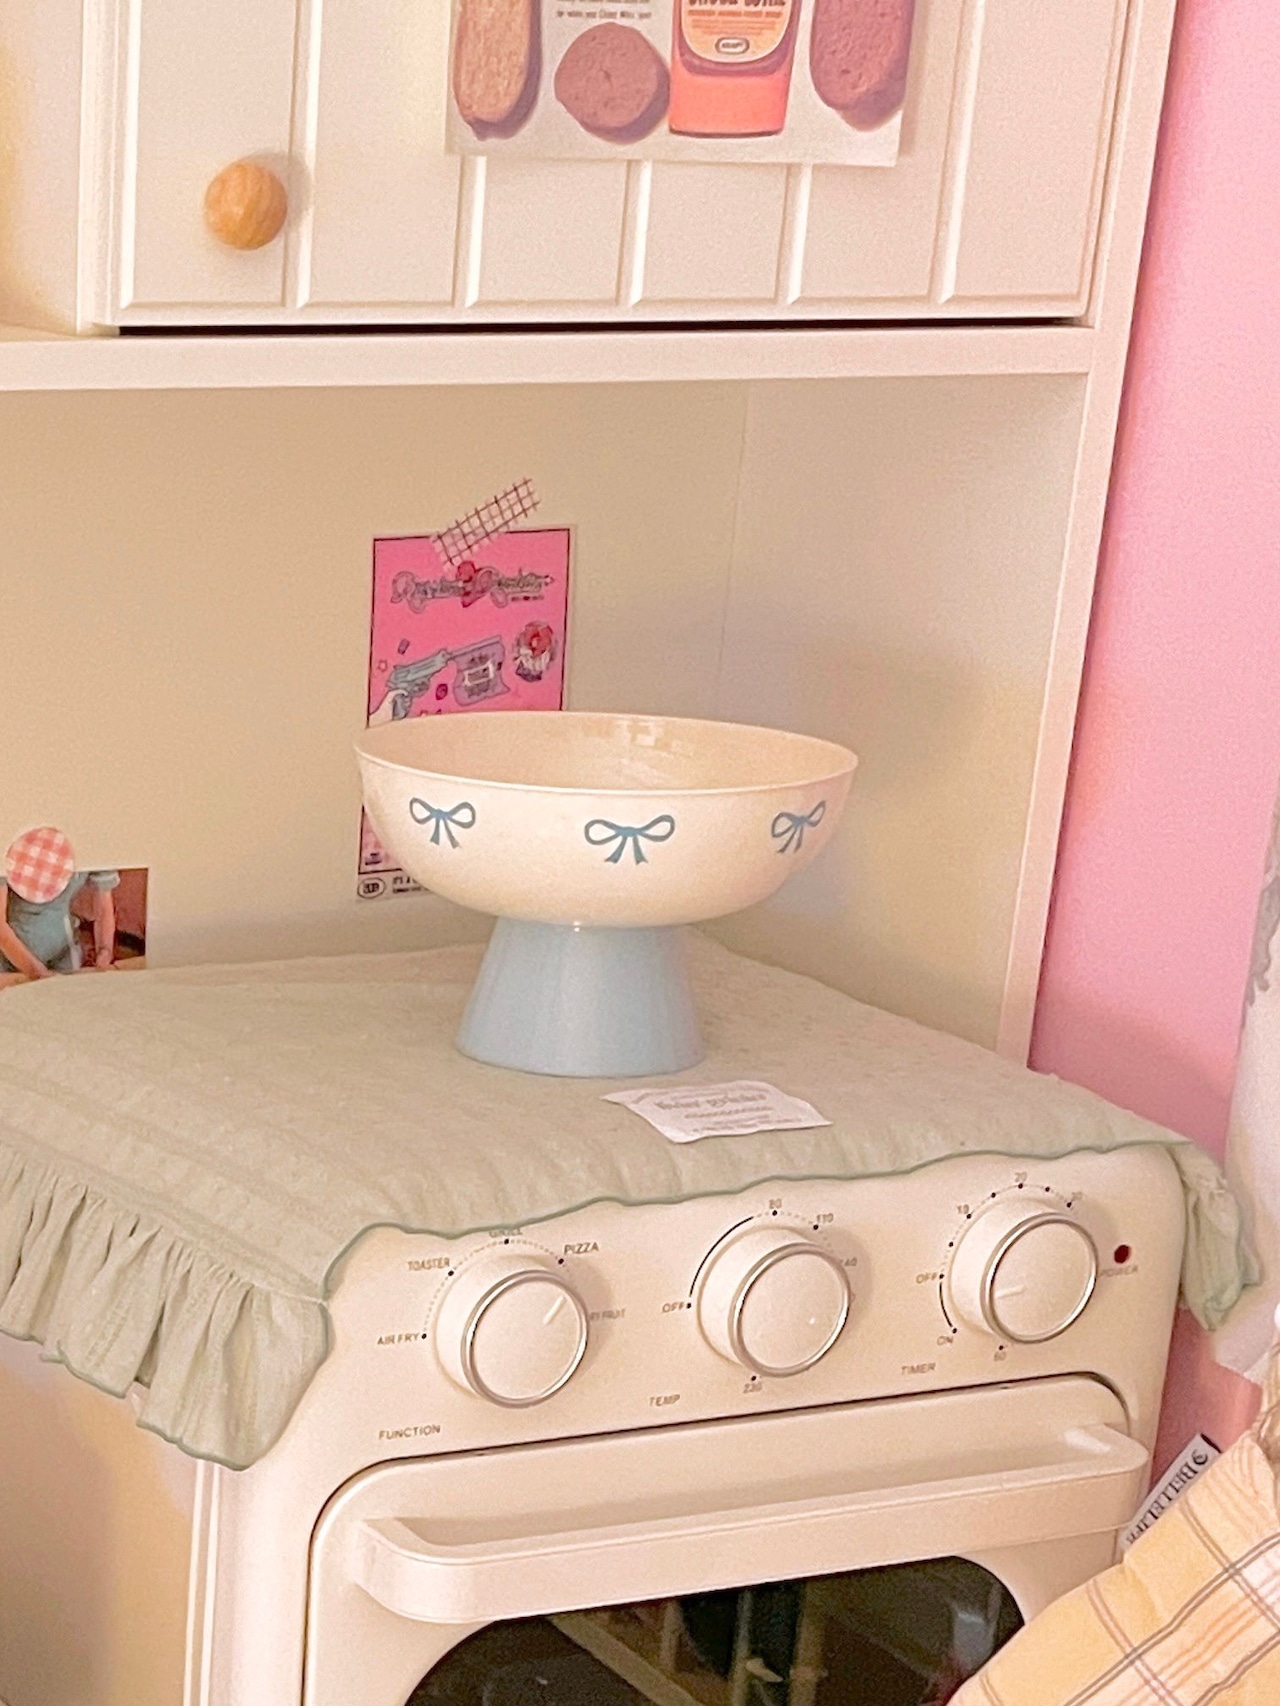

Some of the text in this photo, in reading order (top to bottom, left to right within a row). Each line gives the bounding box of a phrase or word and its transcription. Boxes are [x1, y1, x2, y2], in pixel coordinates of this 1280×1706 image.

[564, 1242, 599, 1255] PIZZA
[408, 1257, 450, 1271] TOASTER
[916, 1272, 937, 1284] OFF
[662, 1303, 685, 1313] OFF
[377, 1332, 420, 1345] AIR FRY
[901, 1362, 936, 1375] TIMER
[649, 1394, 681, 1407] TEMP
[379, 1425, 441, 1440] FUNCTION
